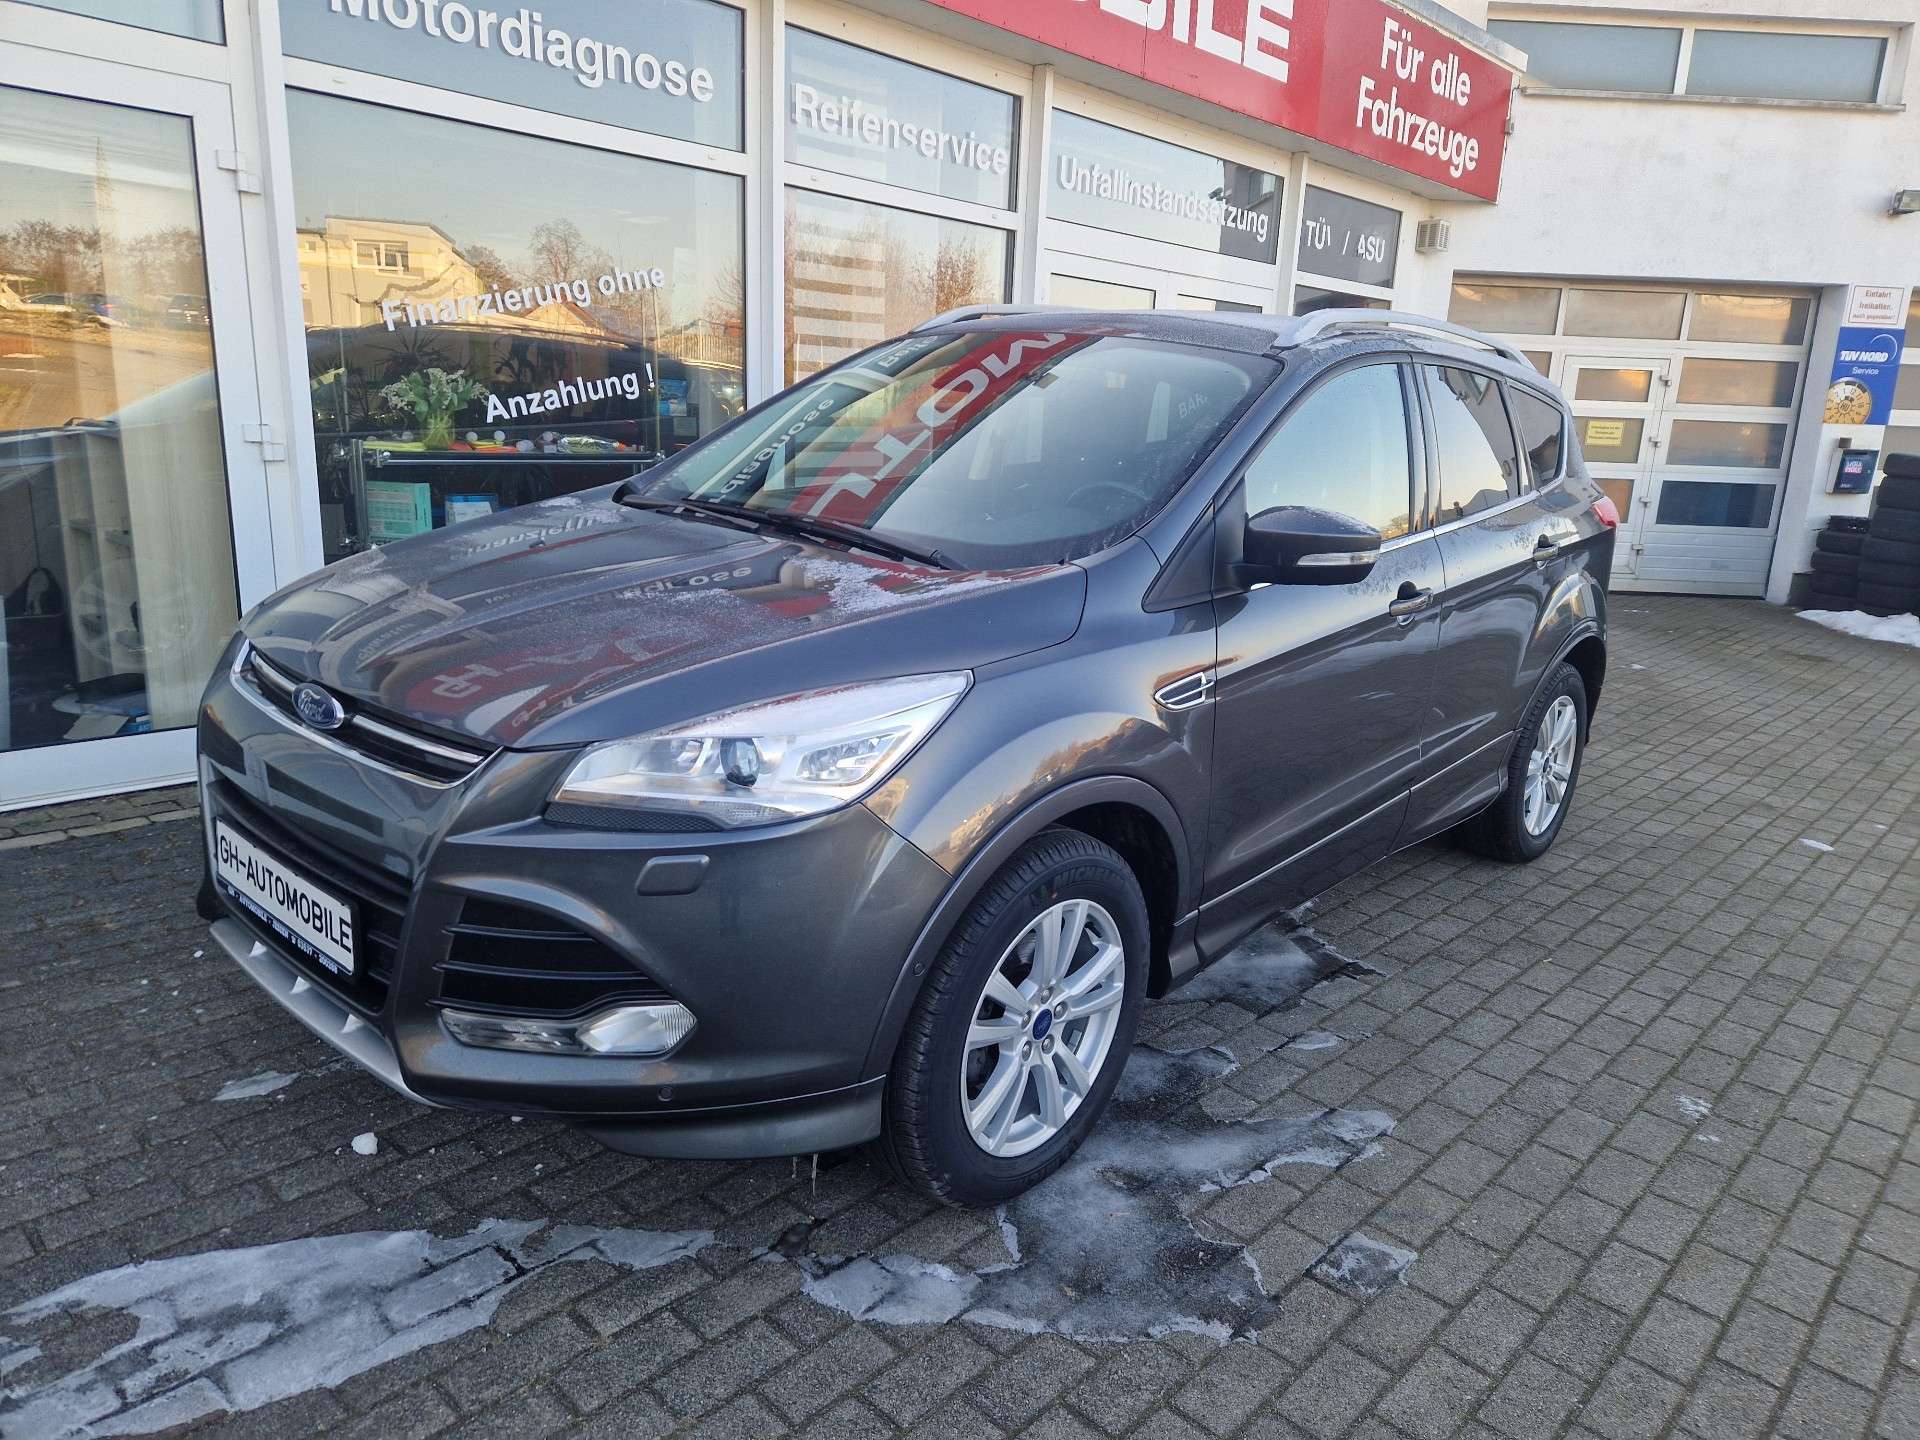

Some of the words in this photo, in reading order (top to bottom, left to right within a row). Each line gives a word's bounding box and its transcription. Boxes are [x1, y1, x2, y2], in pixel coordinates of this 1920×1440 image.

[1381, 16, 1425, 83] Für
[1431, 53, 1471, 106] alle
[794, 83, 1010, 175] Reifenservice
[1356, 75, 1479, 178] Fahrzeuge
[1059, 154, 1269, 243] Unfallinstandsetzung
[380, 278, 591, 332] Finanzierung
[598, 266, 665, 297] ohne
[486, 369, 640, 424] Anzahlung
[644, 362, 656, 389] !
[1851, 366, 1880, 376] Service
[219, 834, 353, 955] GH-AUTOMOBILE
